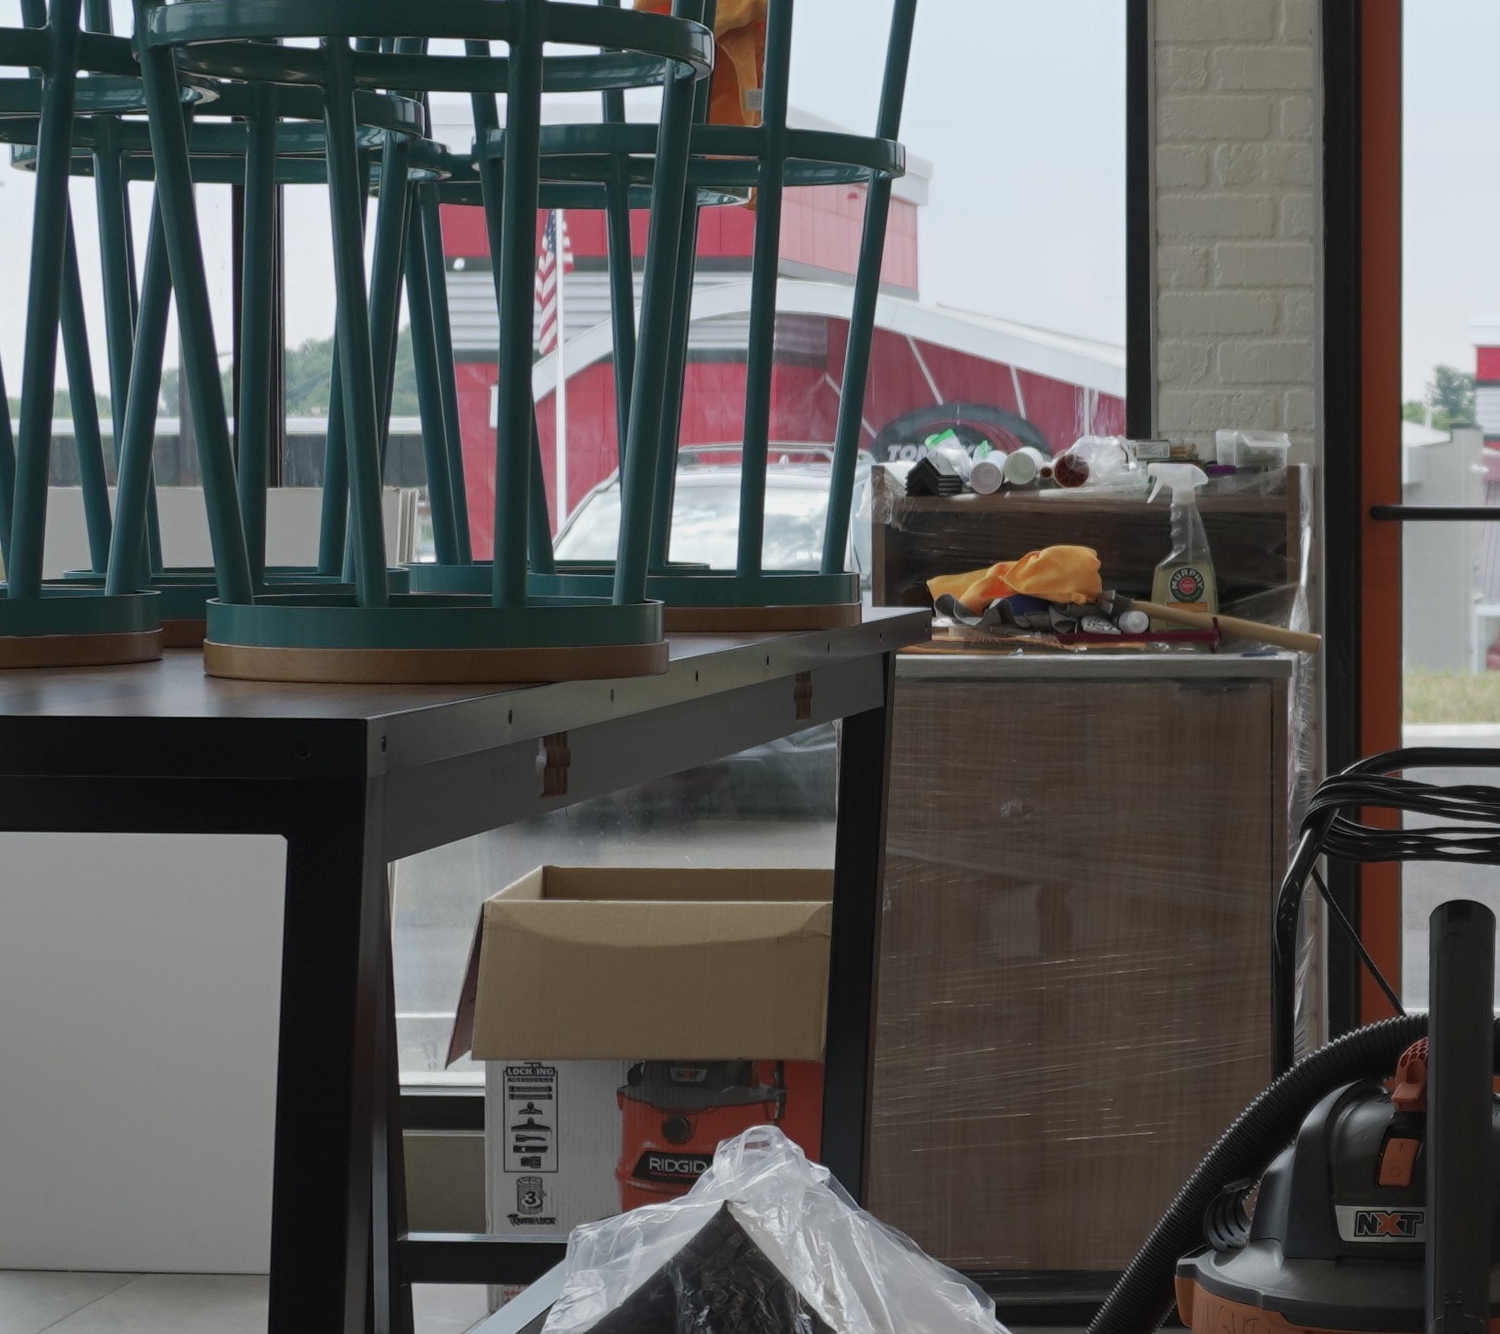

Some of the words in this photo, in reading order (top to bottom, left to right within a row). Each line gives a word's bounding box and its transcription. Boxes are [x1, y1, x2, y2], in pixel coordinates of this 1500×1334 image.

[1171, 568, 1204, 590] MURPHY
[648, 1157, 708, 1174] RIDGID
[525, 1190, 537, 1205] 3
[1355, 1210, 1425, 1237] NXT
